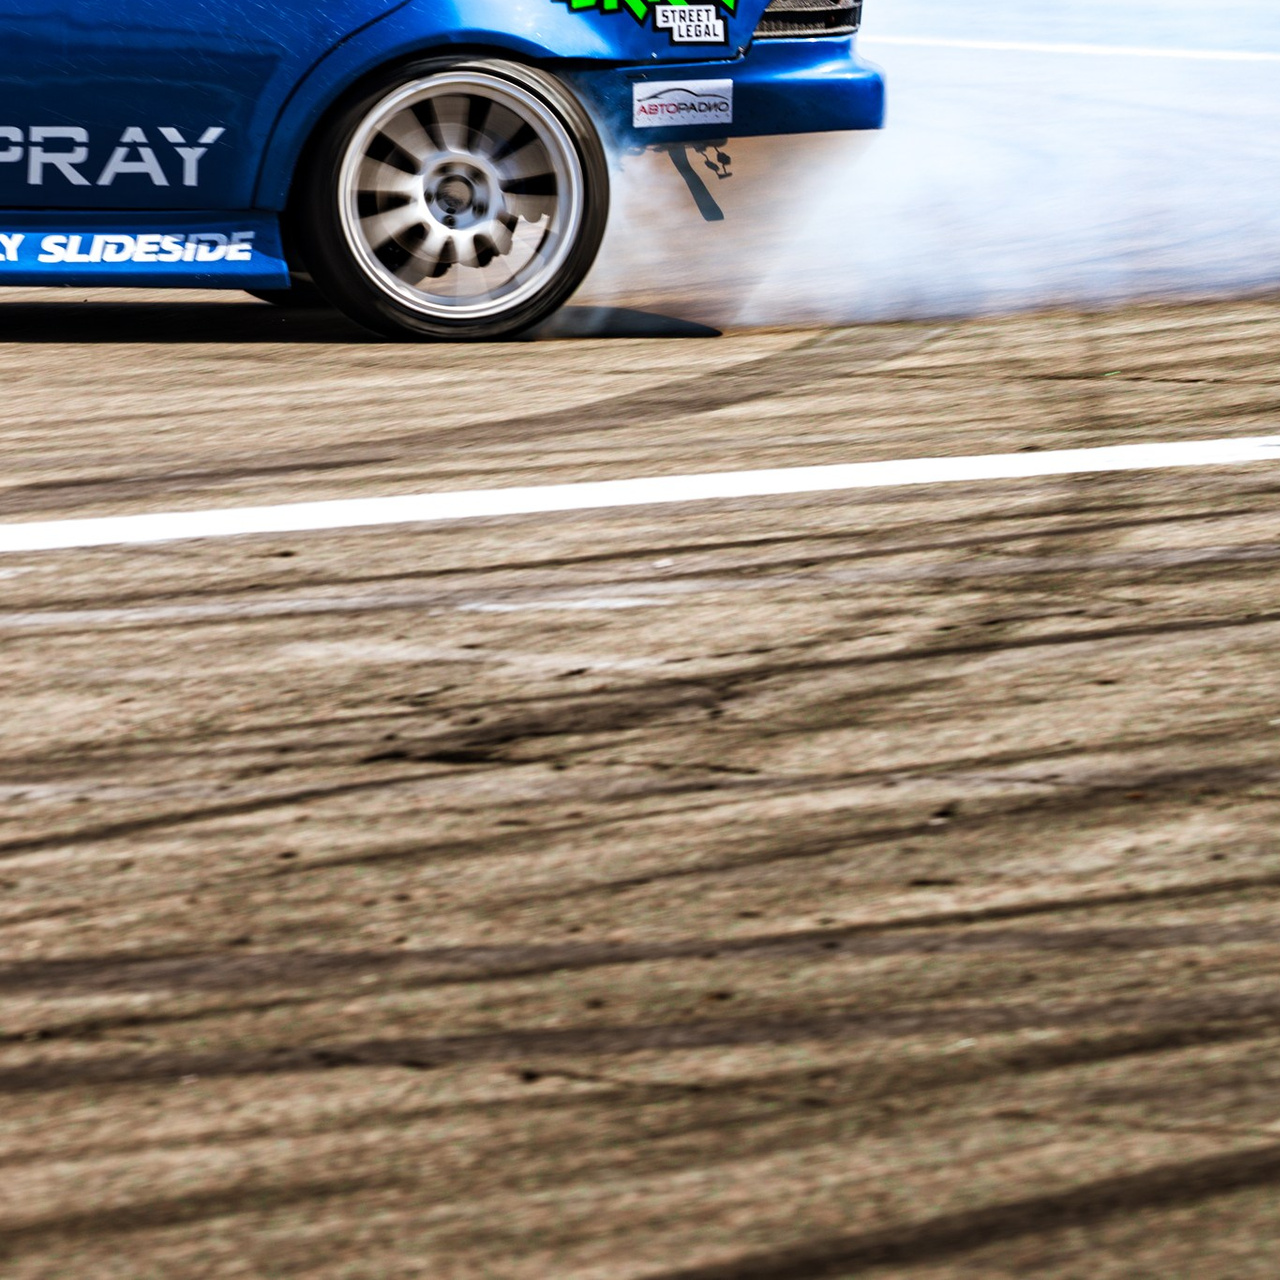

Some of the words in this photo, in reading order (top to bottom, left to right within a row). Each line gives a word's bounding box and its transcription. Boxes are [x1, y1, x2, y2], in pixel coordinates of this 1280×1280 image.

[661, 8, 713, 24] STREET
[677, 23, 720, 38] LEGAL
[637, 101, 730, 116] АВТОРАДИО
[37, 231, 254, 264] SLIDESIDE
